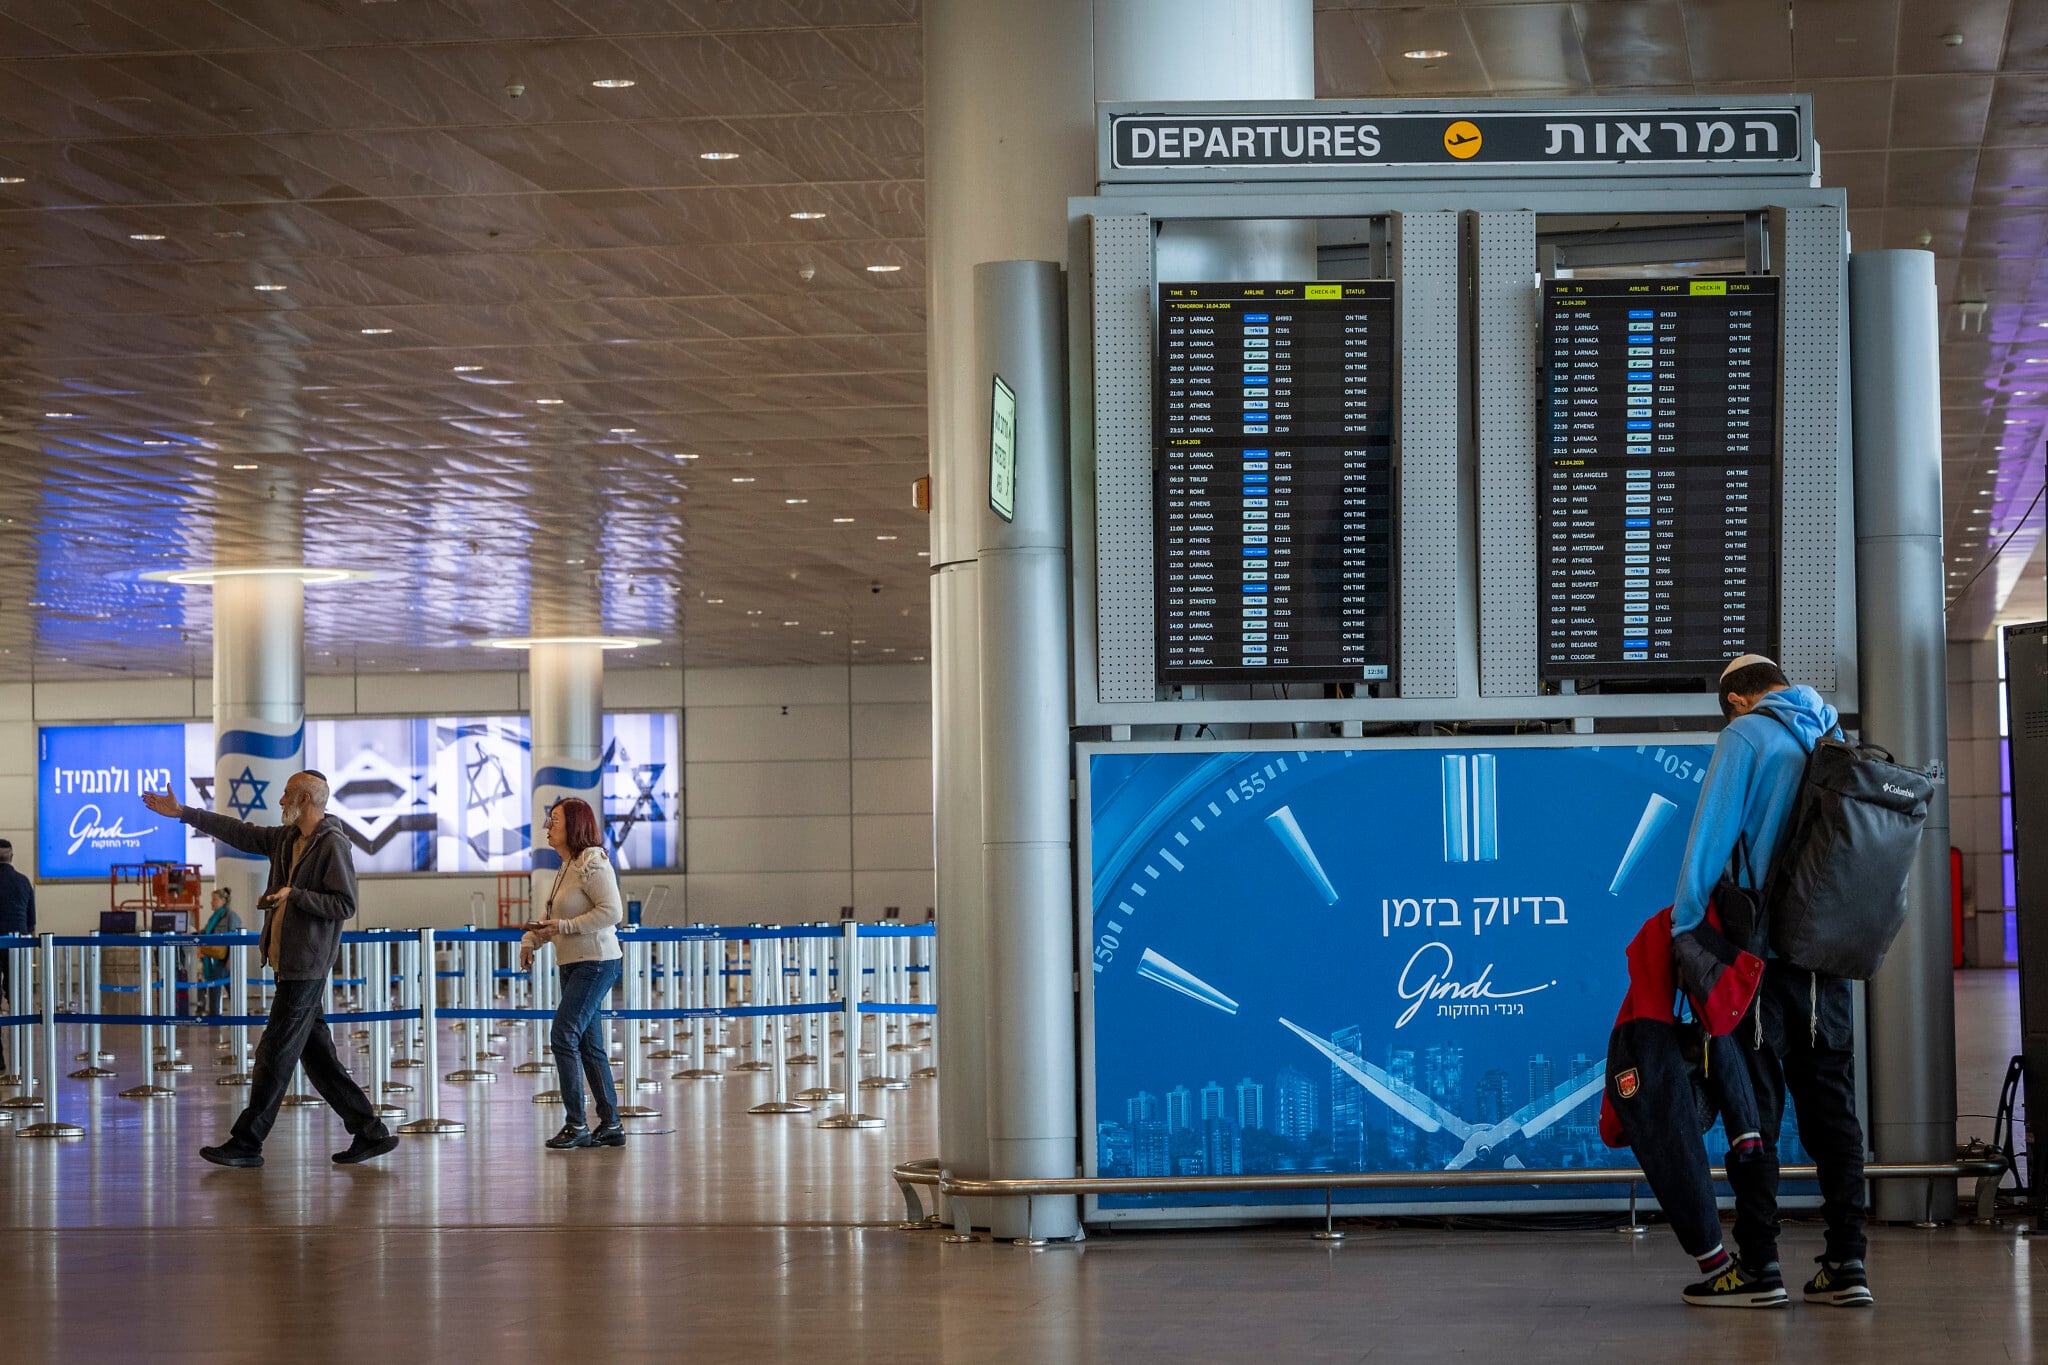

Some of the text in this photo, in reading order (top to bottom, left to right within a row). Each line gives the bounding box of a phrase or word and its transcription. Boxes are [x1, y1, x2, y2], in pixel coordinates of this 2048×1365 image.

[1132, 125, 1380, 158] DEPARTURES
[1545, 122, 1777, 154] המראות
[1188, 561, 1214, 569] LARNACA
[1664, 755, 1692, 779] 05
[55, 766, 171, 796] כאן ולתמיד!
[1239, 772, 1266, 800] 55
[1889, 785, 1914, 798] Columbia
[91, 841, 121, 849] החזקות
[1382, 896, 1569, 937] בדיוק בזמן
[1095, 934, 1119, 963] 50
[1436, 1003, 1524, 1019] גינדי החזקות
[1713, 1269, 1745, 1292] AX
